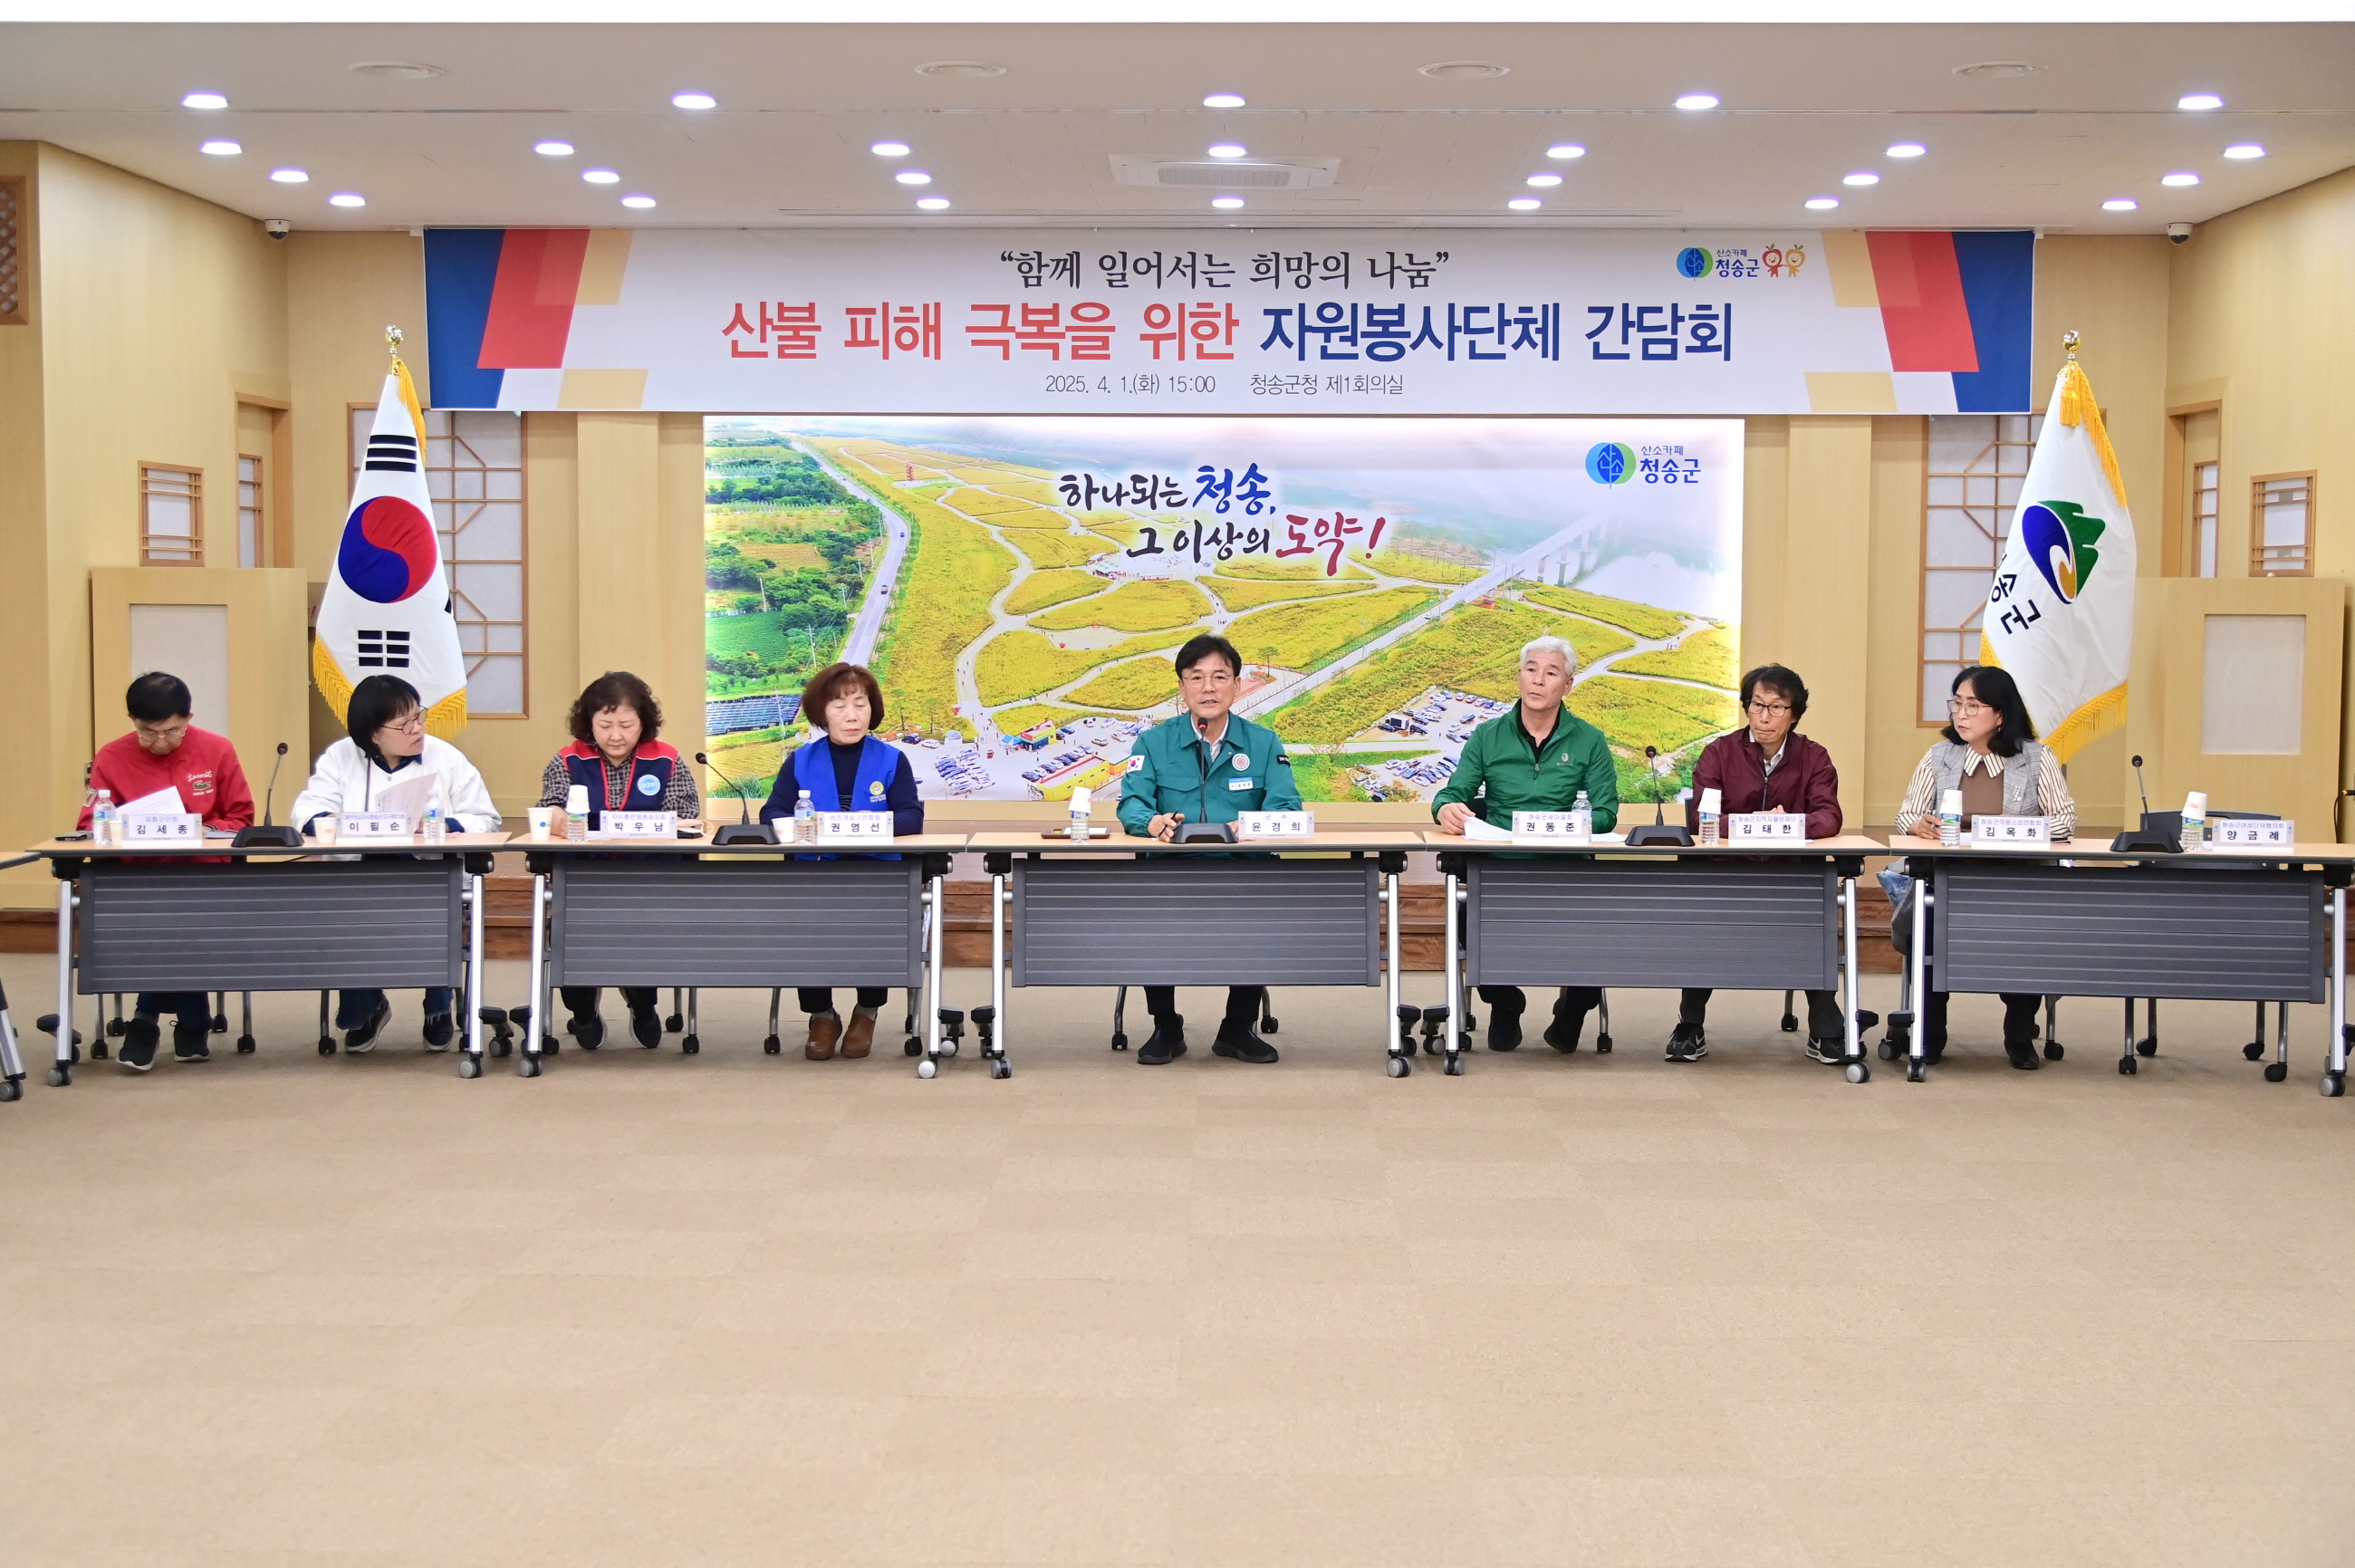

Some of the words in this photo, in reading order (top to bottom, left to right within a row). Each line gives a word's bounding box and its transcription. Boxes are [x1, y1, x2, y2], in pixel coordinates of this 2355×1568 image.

[1716, 249, 1747, 257] 산소카페
[1000, 251, 1081, 290] “함께
[1098, 251, 1236, 290] 일어서는
[1249, 251, 1351, 290] 희망의
[1367, 250, 1449, 290] 나눔”
[1716, 258, 1760, 278] 청송군
[721, 302, 822, 360] 산불
[844, 302, 941, 361] 피해
[965, 302, 1117, 361] 극복을
[1139, 303, 1240, 361] 위한
[1260, 302, 1561, 362] 자원봉사단체
[1584, 302, 1732, 362] 간담회
[1045, 374, 1090, 395] 2025.
[1097, 375, 1112, 394] 4.
[1120, 372, 1160, 396] 1.(화)
[1168, 375, 1216, 393] 15:00
[1250, 373, 1318, 396] 청송군청
[1325, 373, 1404, 396] 제1회의실
[1640, 445, 1684, 456] 산소카페
[1639, 457, 1702, 485] 청송군
[1059, 473, 1188, 510] 하나되는
[1192, 463, 1276, 515] 청송,
[1127, 527, 1164, 557] 그
[1173, 519, 1269, 563] 이상의
[1275, 512, 1386, 576] 도약!
[1991, 553, 2042, 635] 송군
